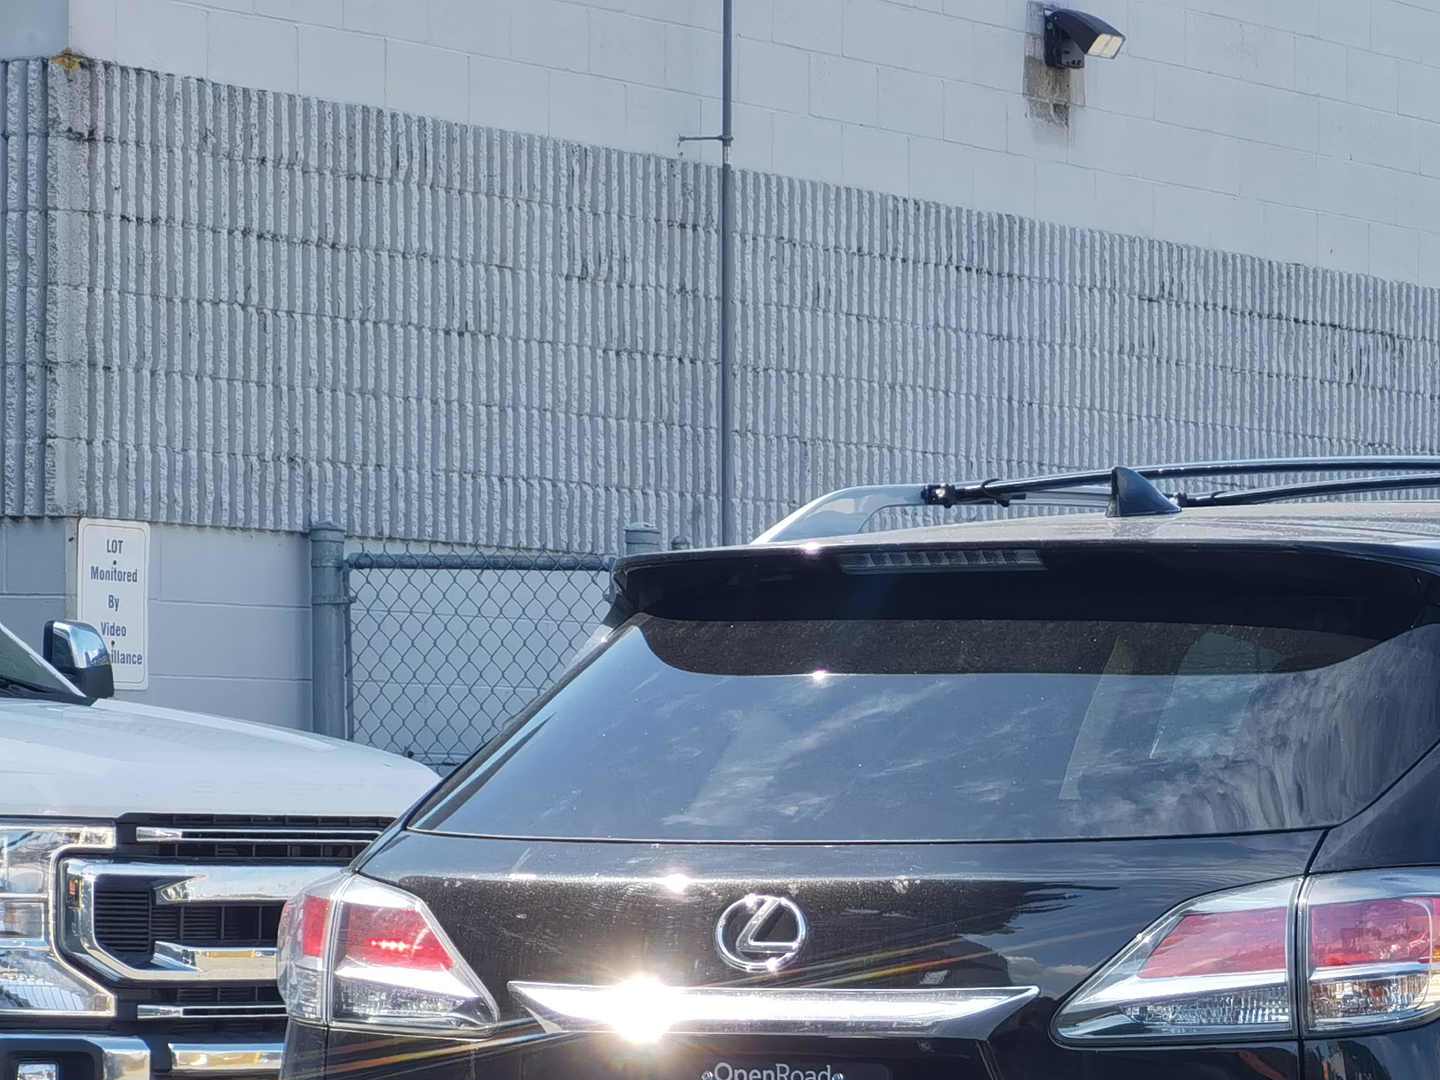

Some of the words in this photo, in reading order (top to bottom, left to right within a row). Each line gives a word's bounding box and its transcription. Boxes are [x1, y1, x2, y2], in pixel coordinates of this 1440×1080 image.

[106, 539, 123, 554] LOT
[90, 566, 138, 583] Monitored
[108, 595, 120, 611] By
[100, 622, 127, 637] Video
[111, 649, 143, 665] illance
